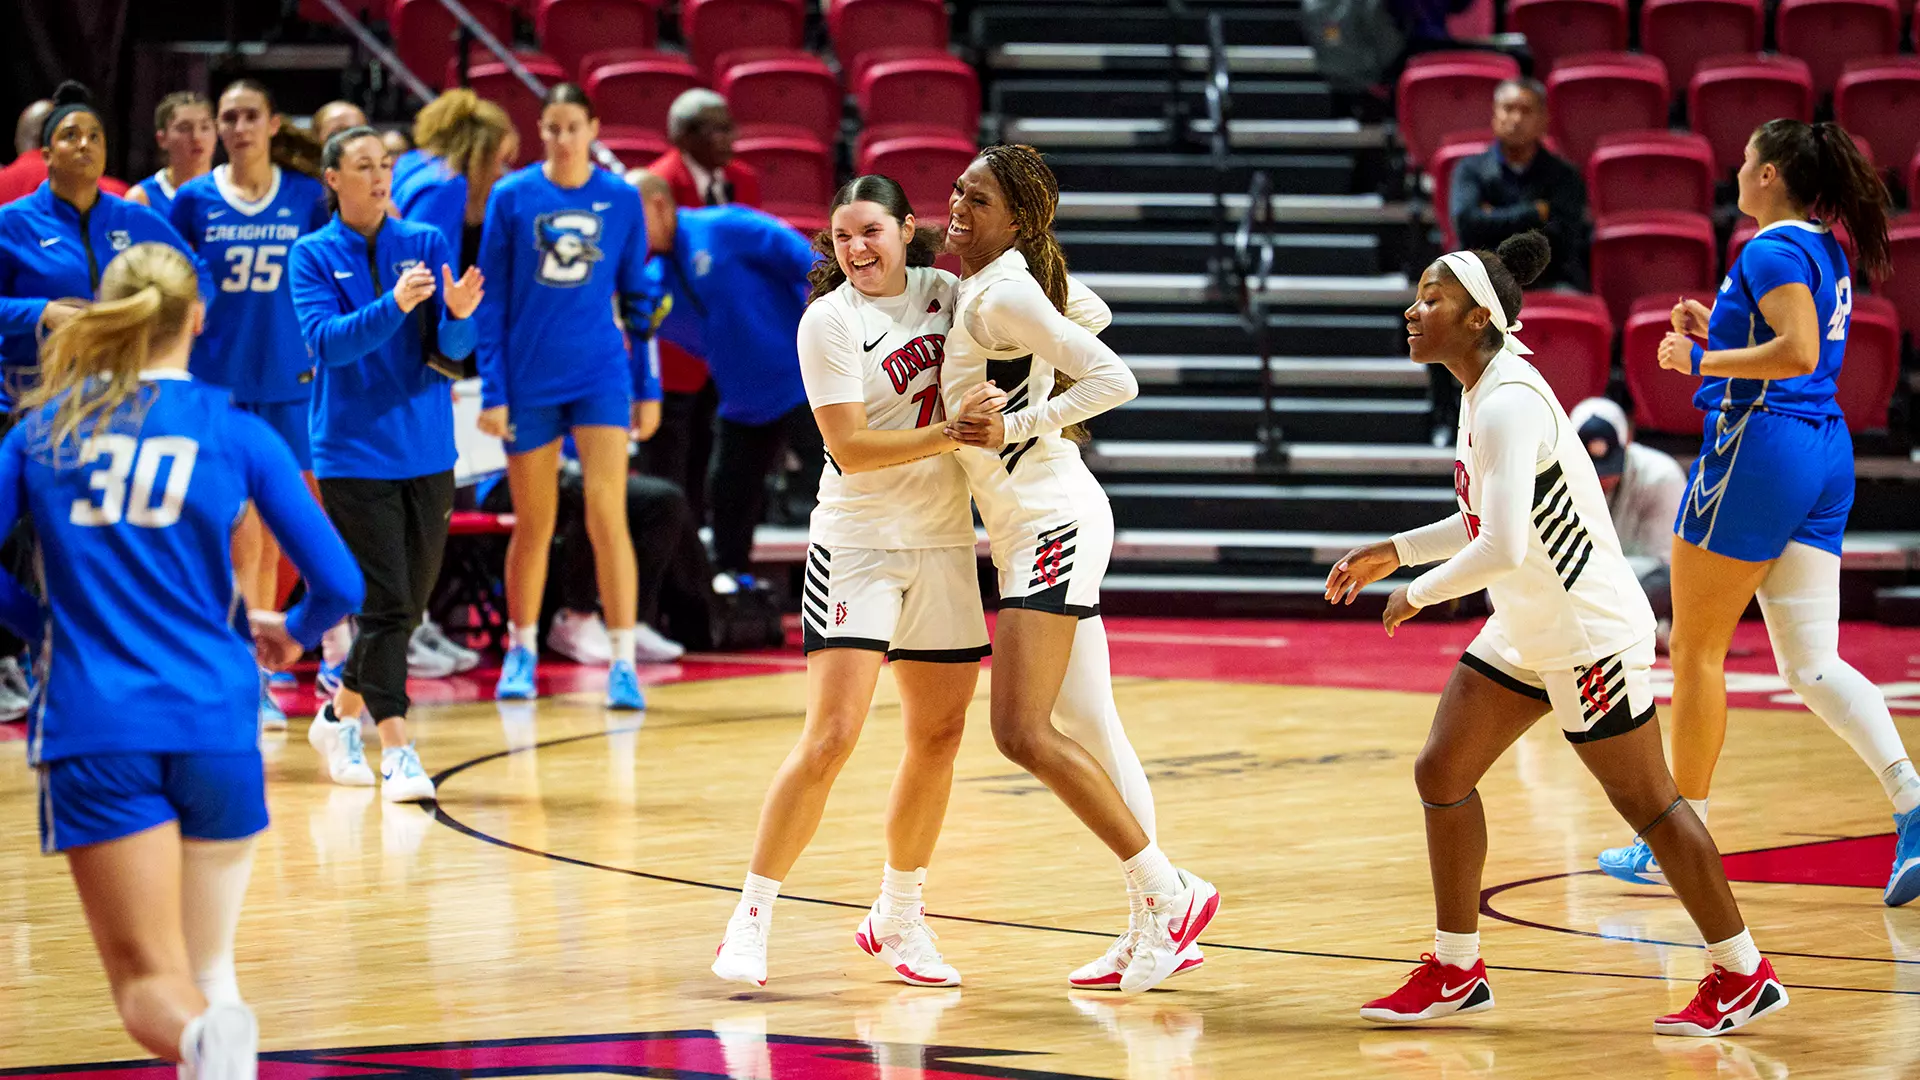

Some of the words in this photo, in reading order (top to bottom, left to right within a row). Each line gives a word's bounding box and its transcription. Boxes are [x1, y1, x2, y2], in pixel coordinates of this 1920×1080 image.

[205, 224, 300, 242] CREIGHTON
[221, 245, 287, 292] 35
[69, 434, 199, 527] 30
